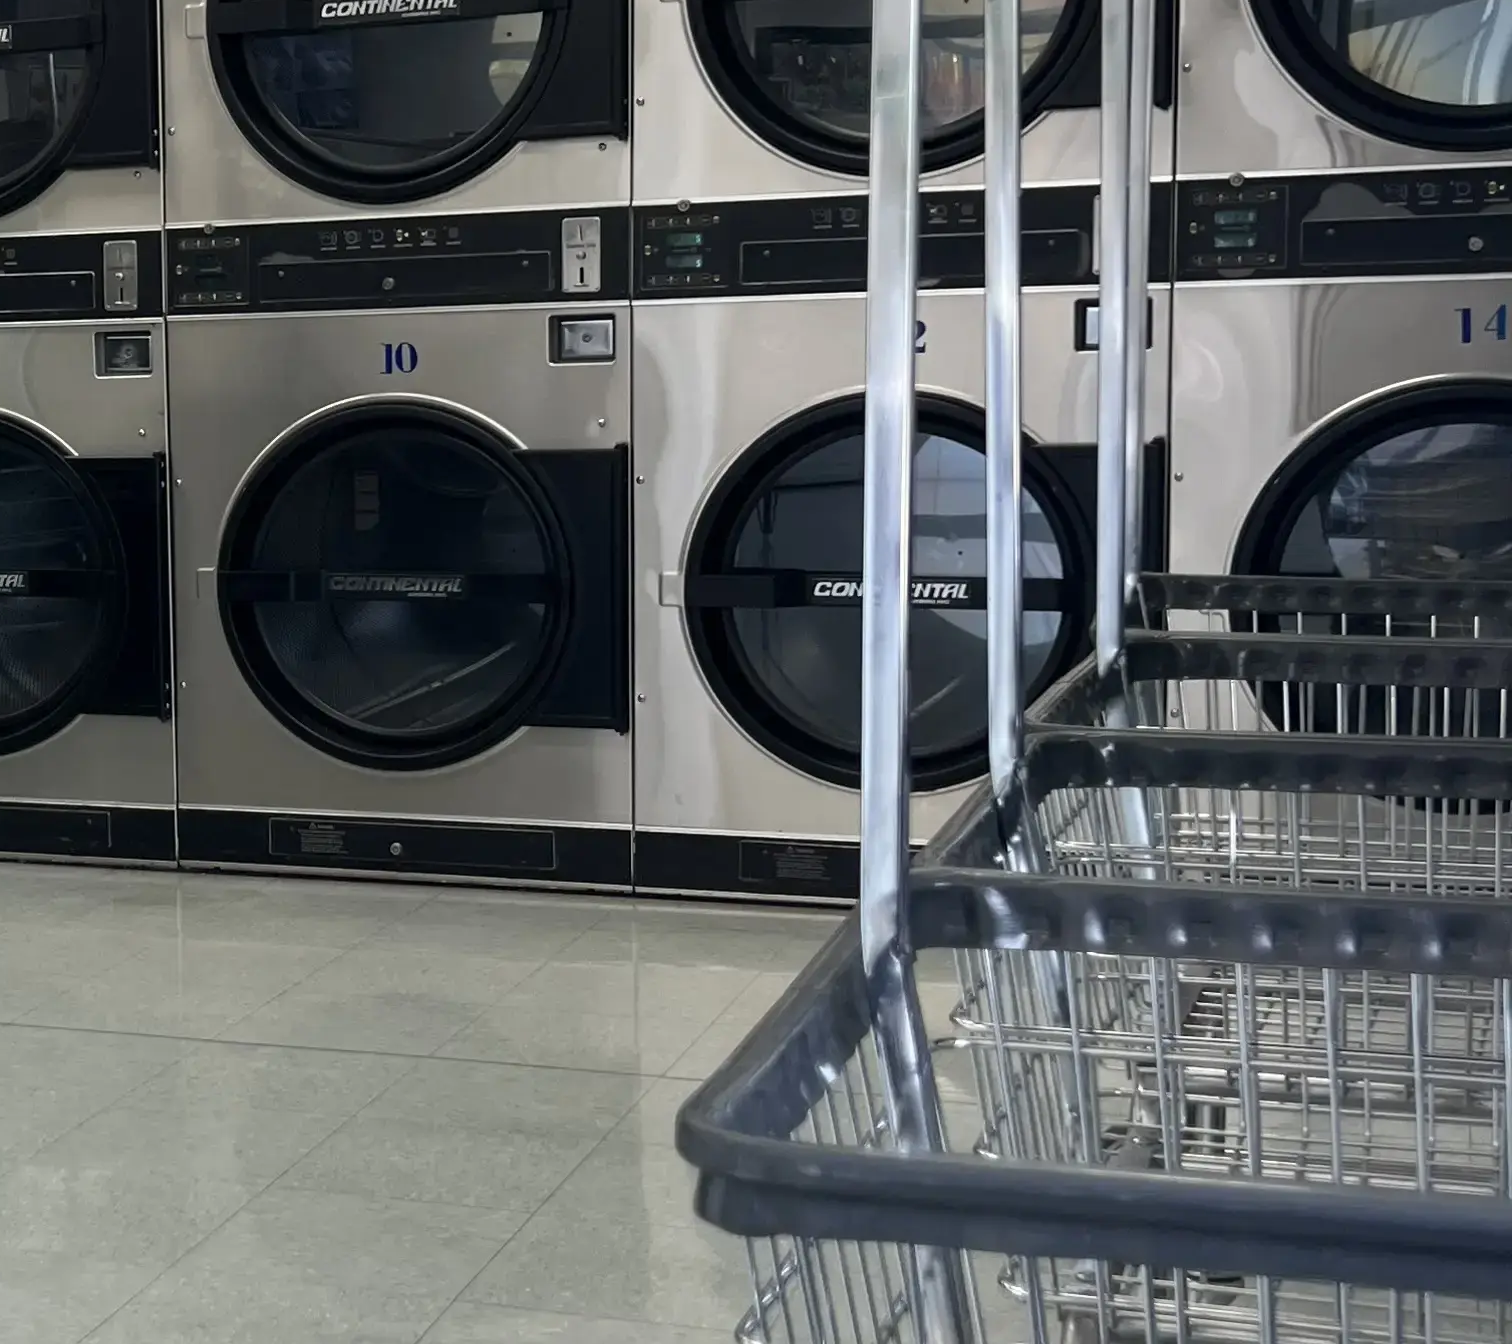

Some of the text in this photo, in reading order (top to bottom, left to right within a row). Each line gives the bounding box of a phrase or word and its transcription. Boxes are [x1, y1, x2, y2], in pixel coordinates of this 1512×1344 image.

[1454, 304, 1507, 343] 14
[380, 341, 418, 375] 10
[330, 576, 463, 593] CONTINENTAL
[813, 581, 969, 599] CONNTAL
